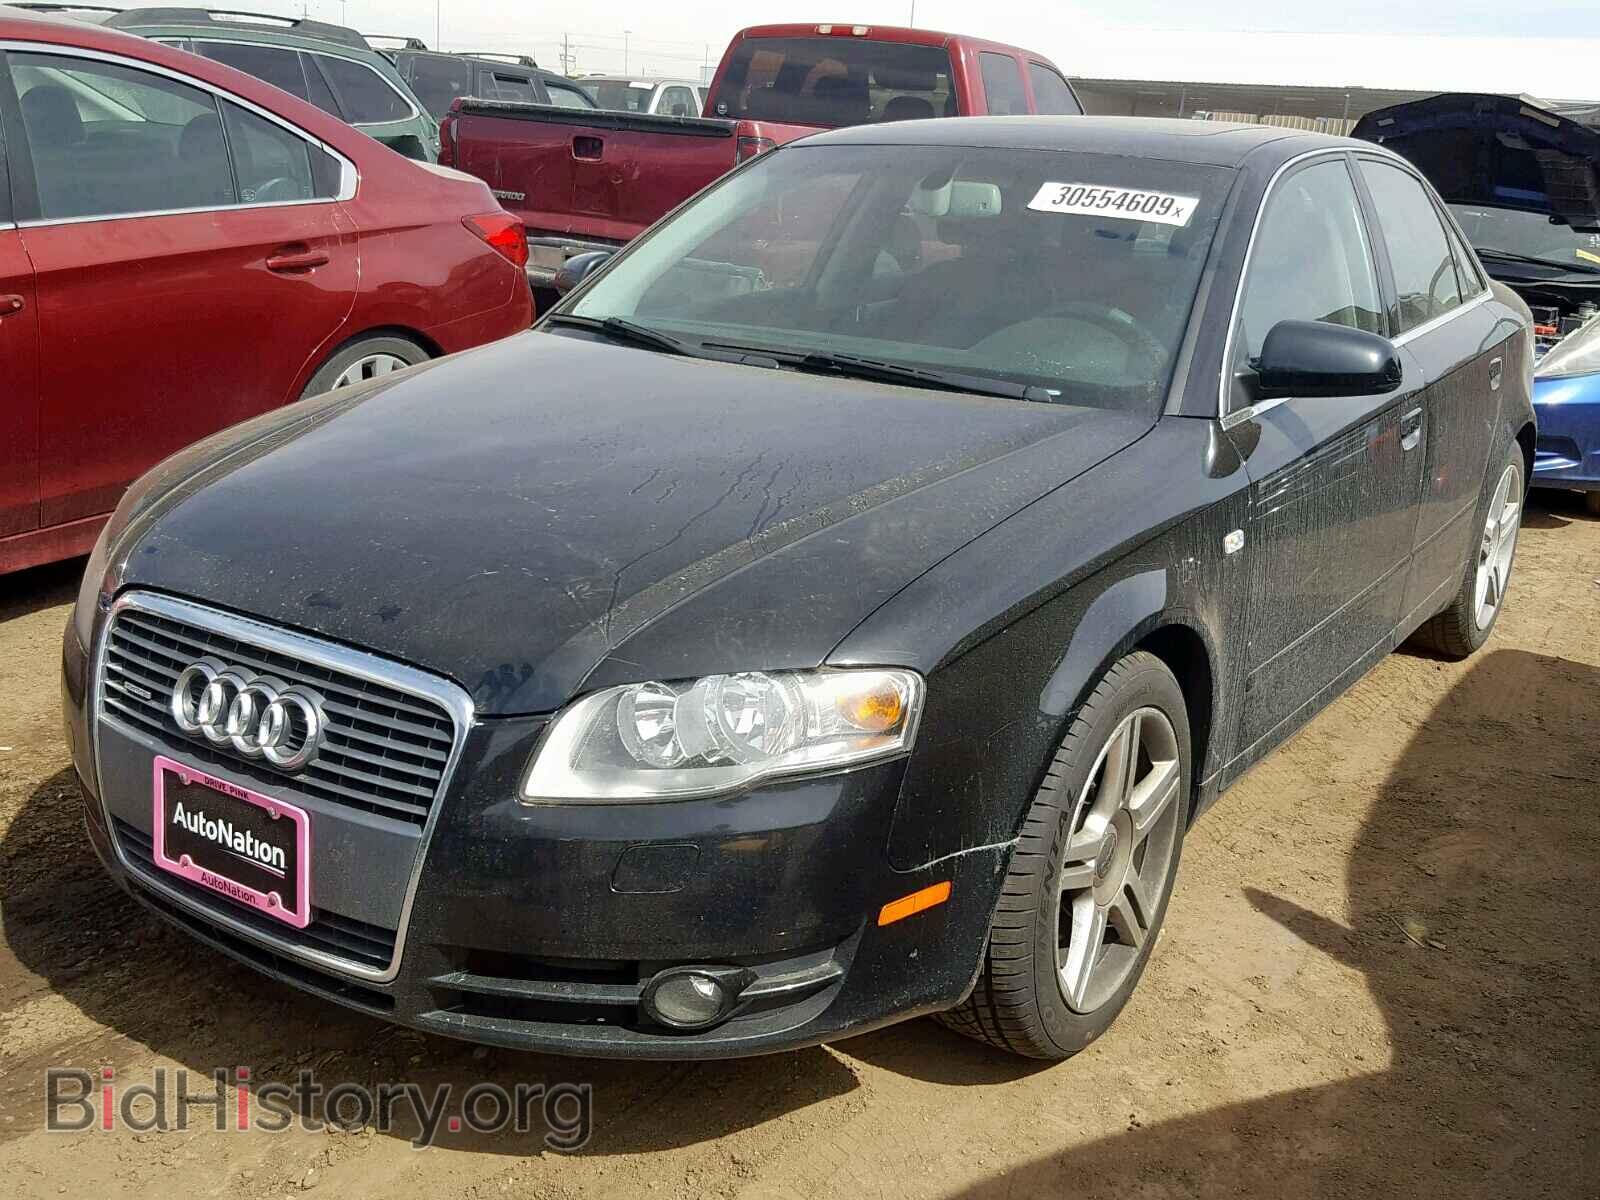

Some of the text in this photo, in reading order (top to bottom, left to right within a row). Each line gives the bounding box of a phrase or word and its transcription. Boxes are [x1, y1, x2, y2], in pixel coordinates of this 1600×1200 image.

[204, 776, 249, 800] DRIVE PINK
[173, 802, 286, 868] AutoNation
[200, 872, 256, 904] AutoNation
